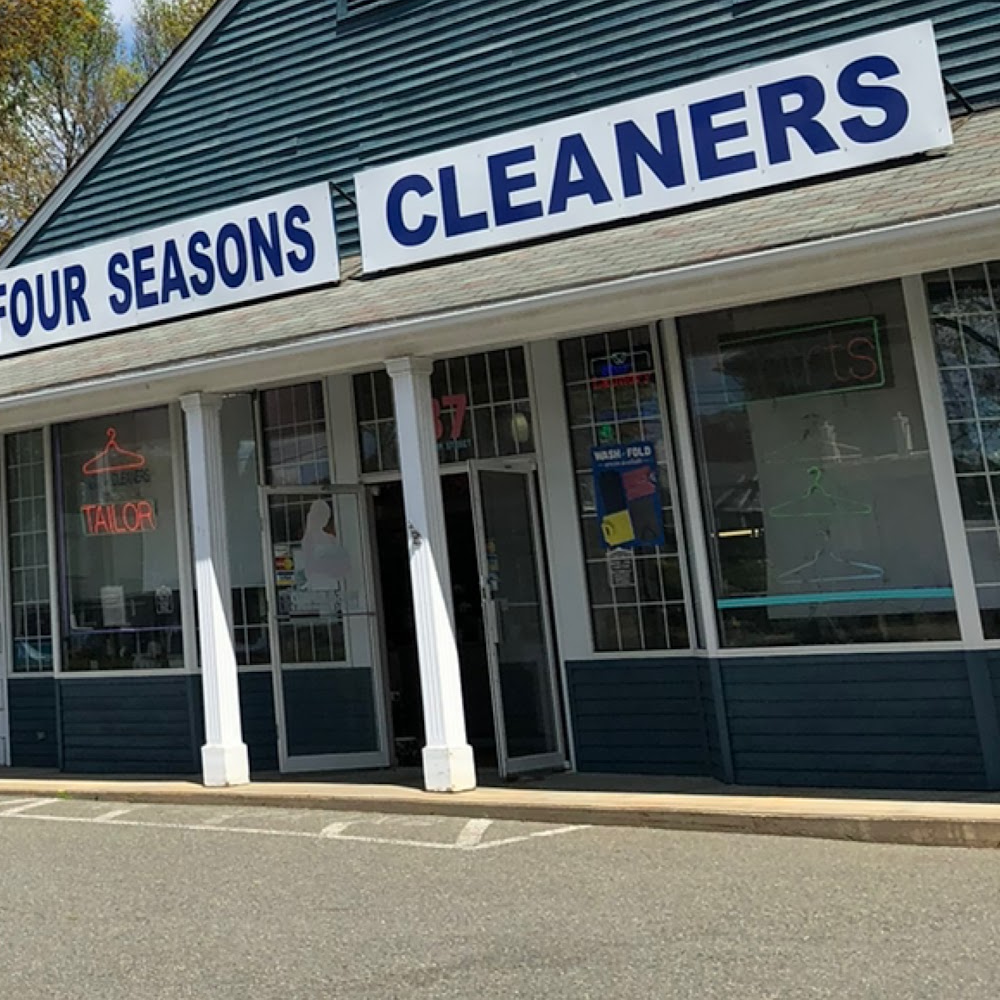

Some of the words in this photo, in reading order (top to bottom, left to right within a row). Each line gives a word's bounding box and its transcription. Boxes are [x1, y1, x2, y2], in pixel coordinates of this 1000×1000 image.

[385, 55, 911, 248] CLEANERS
[107, 204, 316, 316] SEASONS
[626, 445, 652, 458] FOLD
[81, 500, 156, 532] TAILOR
